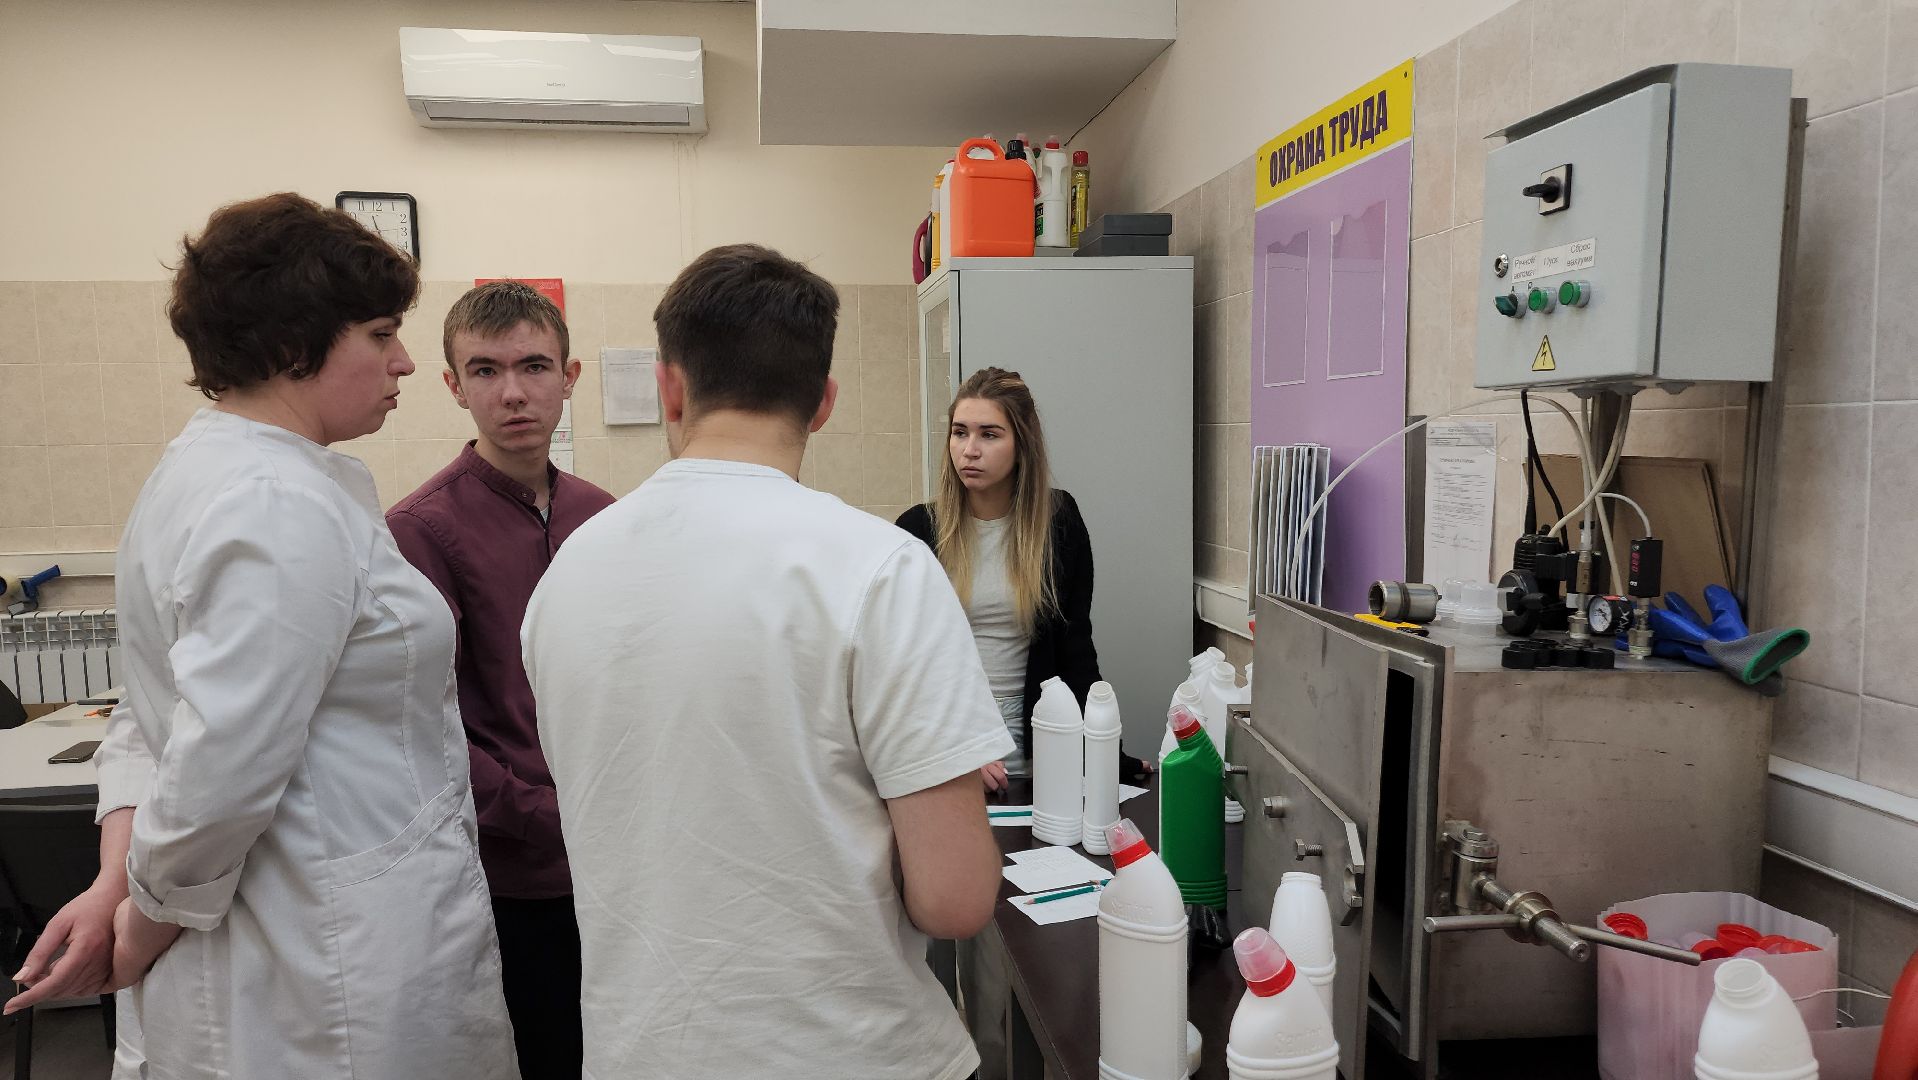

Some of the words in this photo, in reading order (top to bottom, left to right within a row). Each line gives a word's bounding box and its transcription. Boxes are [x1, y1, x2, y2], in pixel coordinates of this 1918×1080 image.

[1269, 124, 1326, 188] ОХРАНА
[1328, 89, 1389, 157] ТРУДА
[372, 201, 383, 212] 12
[400, 213, 408, 224] 2
[400, 226, 408, 237] 3
